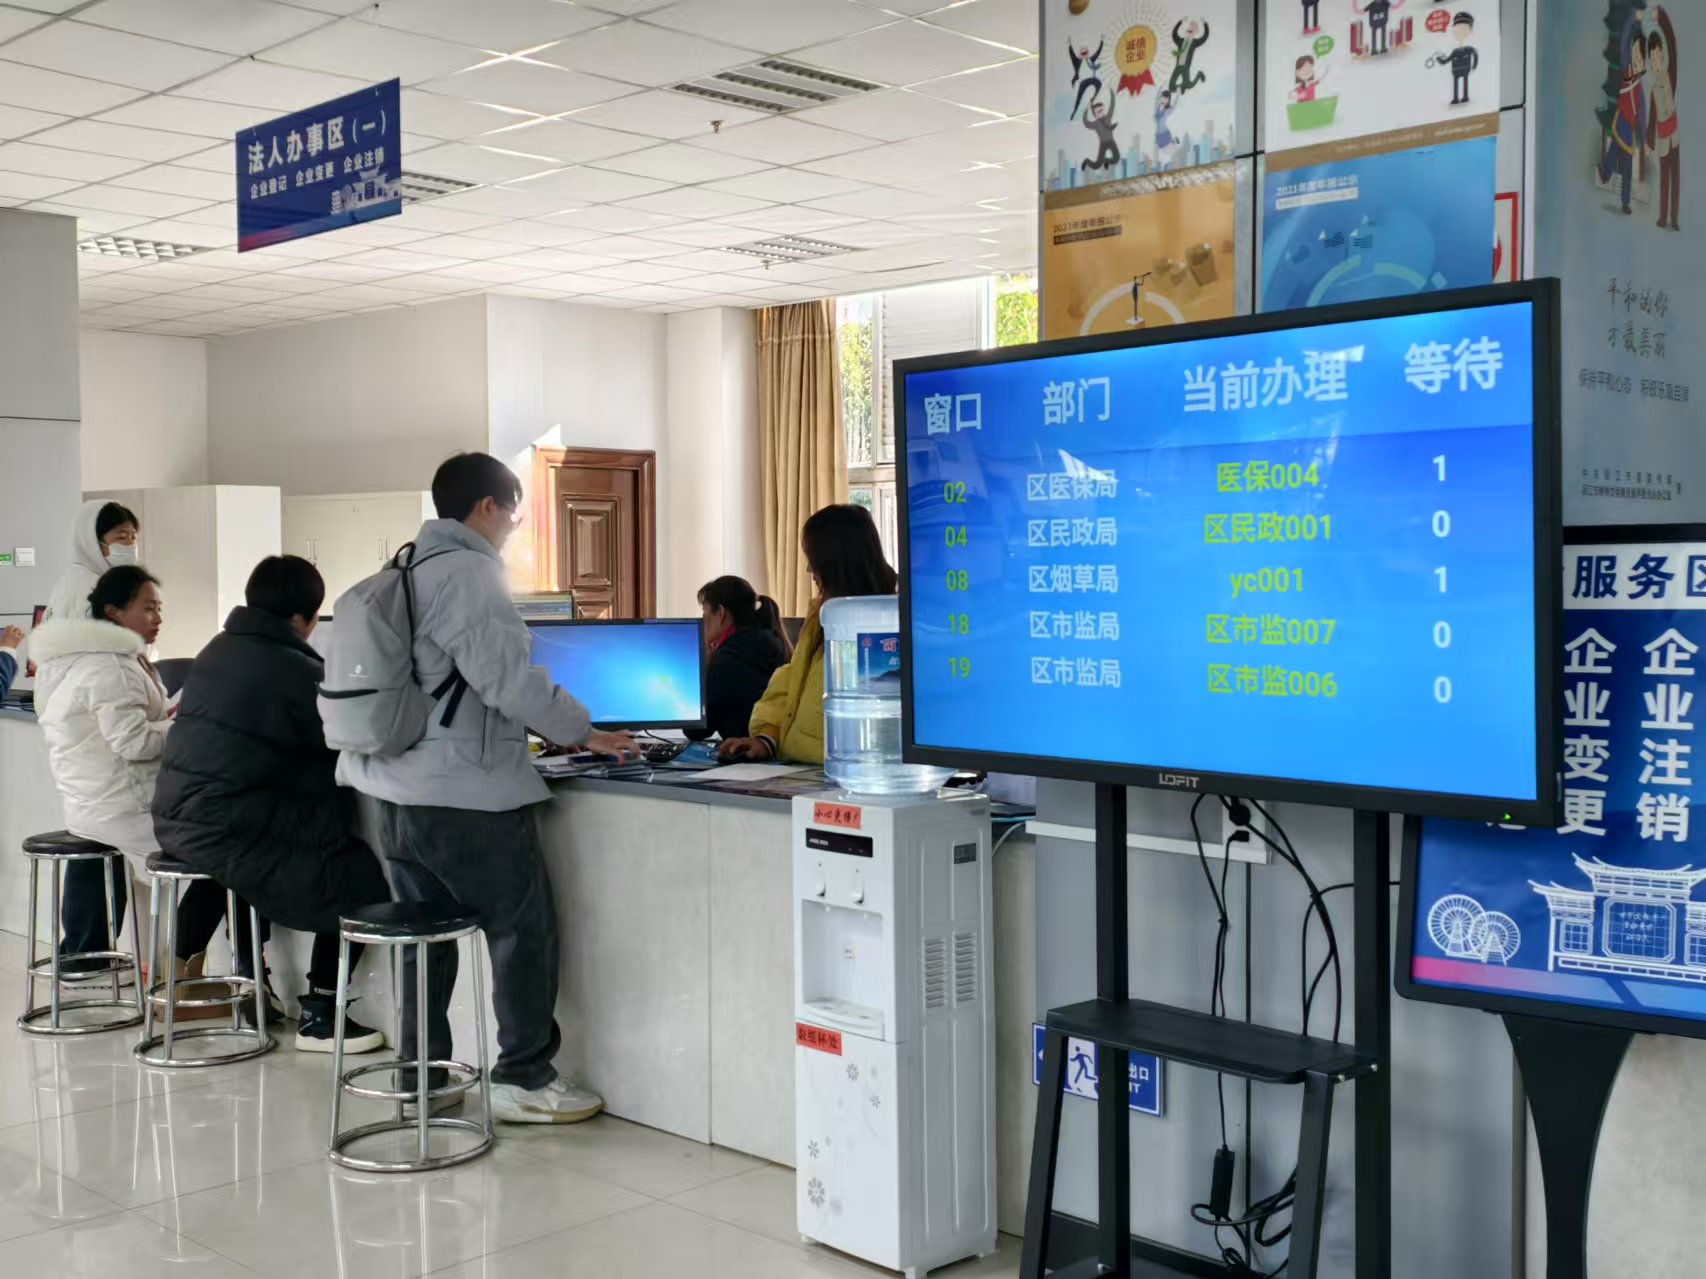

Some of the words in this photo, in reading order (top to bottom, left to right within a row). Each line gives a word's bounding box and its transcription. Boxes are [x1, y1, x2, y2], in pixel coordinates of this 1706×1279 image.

[250, 175, 287, 199] 企业登记
[295, 162, 334, 187] 企业变更
[343, 147, 384, 173] 企业注销
[924, 392, 982, 436] 窗口
[1042, 376, 1111, 426] 部门
[1183, 350, 1350, 413] 当前办理
[1403, 335, 1504, 394] 等待
[943, 481, 967, 504] 02
[1026, 469, 1118, 501] 区医保局
[1216, 460, 1320, 493] 医保004
[1431, 454, 1447, 482] 1
[944, 526, 968, 548] 04
[1027, 517, 1118, 548] 区民政局
[1204, 512, 1332, 544] 区民政001
[1431, 509, 1451, 538] 0
[945, 569, 969, 592] 08
[1028, 564, 1119, 594] 区烟草局
[1229, 567, 1304, 598] yc001
[1433, 565, 1448, 593] 1
[946, 613, 970, 636] 18
[1029, 610, 1120, 641] 区市监局
[1205, 613, 1337, 645] 区市监007
[1432, 620, 1452, 649] 0
[948, 656, 971, 679] 19
[1031, 655, 1121, 688] 区市监局
[1207, 663, 1338, 698] 区市监006
[1433, 675, 1453, 704] 0
[1557, 627, 1617, 837] 企业变更
[1636, 627, 1699, 843] 企业注销
[1128, 1062, 1149, 1081] 出口
